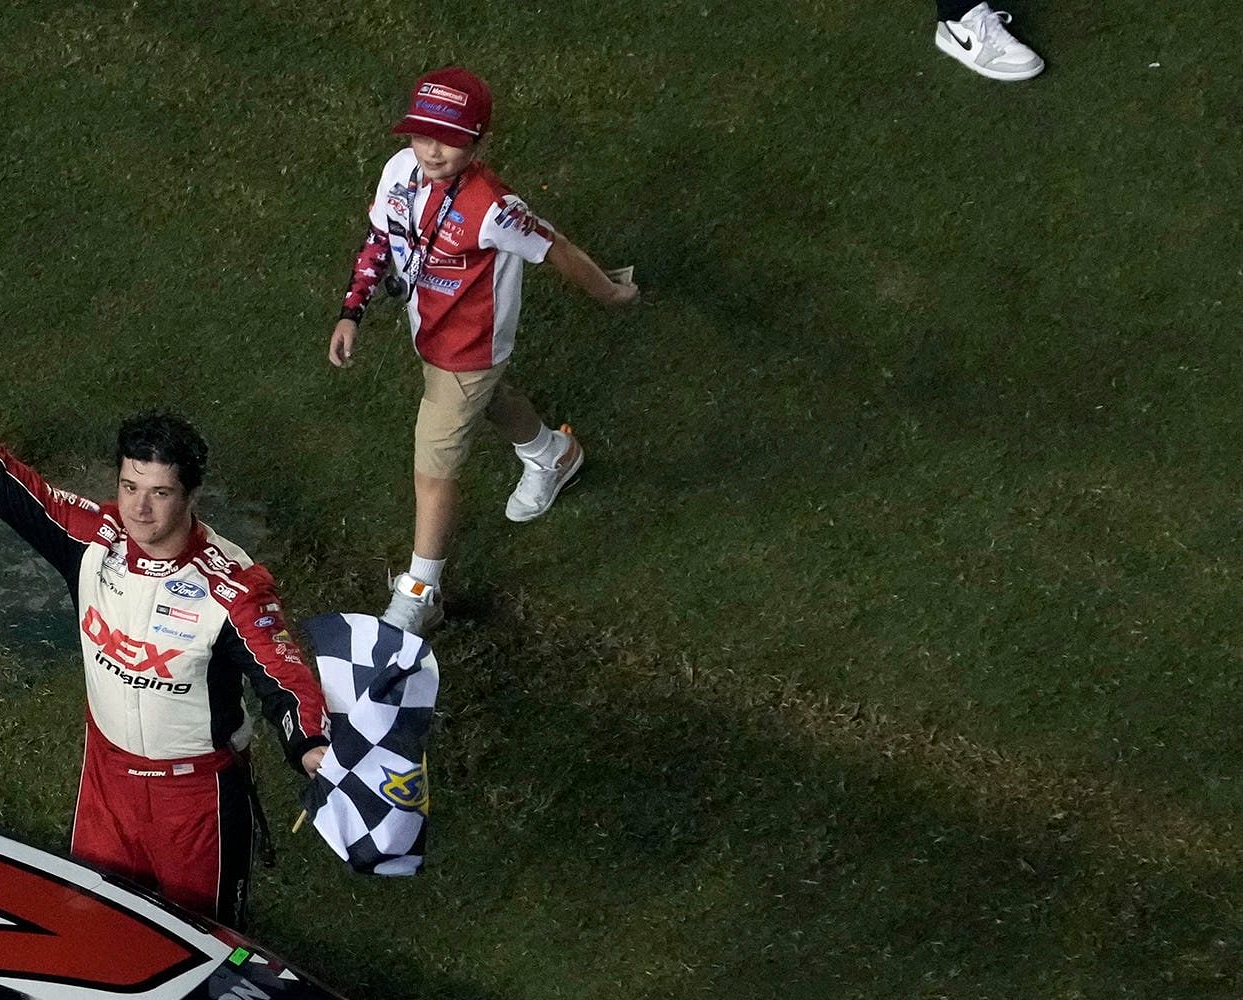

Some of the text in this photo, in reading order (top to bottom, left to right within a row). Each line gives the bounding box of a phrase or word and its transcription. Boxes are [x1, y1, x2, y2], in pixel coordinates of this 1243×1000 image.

[137, 558, 176, 572] DEX
[171, 581, 198, 597] Ford
[217, 585, 236, 600] OMP
[82, 605, 185, 679] DEX
[95, 650, 192, 694] imaging
[128, 768, 166, 777] BURTON
